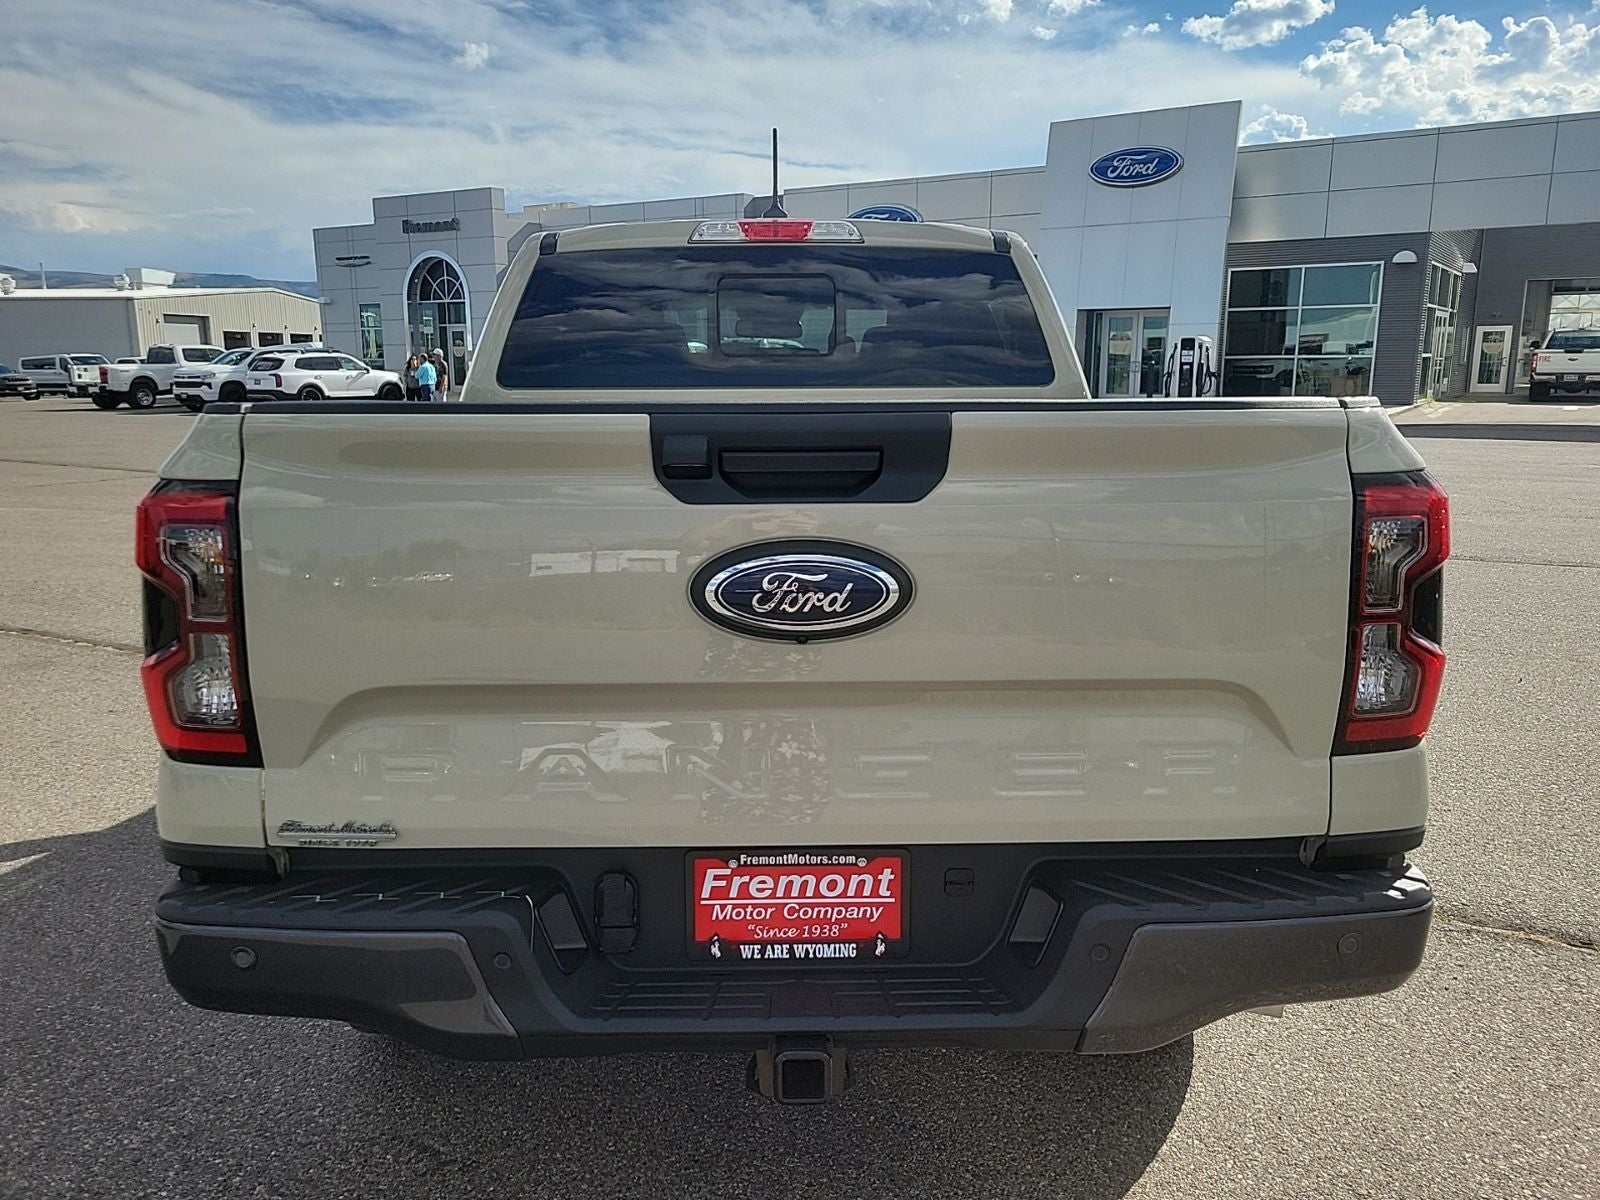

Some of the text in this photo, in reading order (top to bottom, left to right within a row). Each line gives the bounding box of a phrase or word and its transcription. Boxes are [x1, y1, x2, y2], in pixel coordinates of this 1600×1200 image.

[1107, 154, 1159, 178] Ford
[752, 571, 854, 613] Ford
[355, 747, 1242, 802] RANGER
[740, 854, 856, 865] FremontMotors.com
[701, 868, 895, 899] Fremont
[711, 903, 884, 922] Motor Company
[740, 943, 857, 959] WE ARE WYOMING
